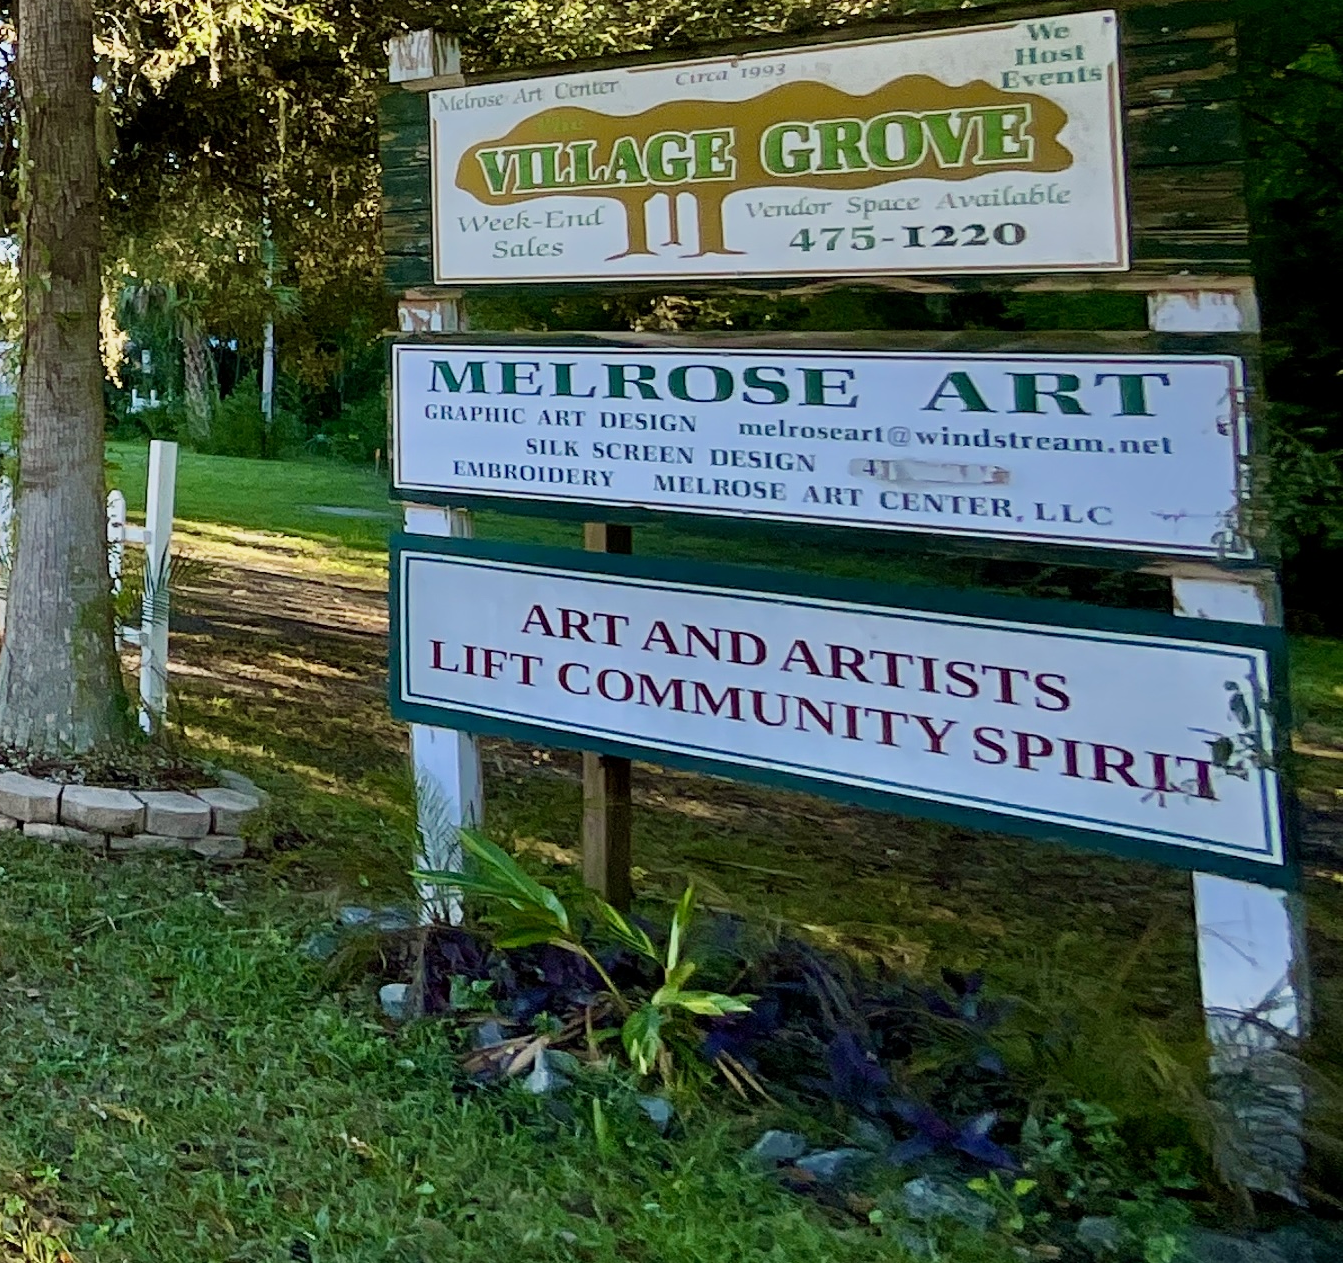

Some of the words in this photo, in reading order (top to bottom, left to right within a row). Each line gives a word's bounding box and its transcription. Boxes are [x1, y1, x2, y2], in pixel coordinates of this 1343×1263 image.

[1026, 23, 1071, 40] We
[1015, 44, 1085, 66] Host
[675, 69, 729, 86] Circa
[740, 63, 787, 79] 1993
[1001, 64, 1103, 89] Events
[438, 91, 505, 112] Melrose
[512, 87, 544, 106] Art
[554, 78, 621, 99] Center
[476, 128, 737, 195] VILLAGE
[760, 103, 1034, 177] GROVE
[746, 196, 832, 218] Vendor
[846, 195, 920, 220] Space
[935, 183, 1071, 210] Available
[457, 205, 606, 232] Week-End
[492, 236, 564, 259] Sales
[788, 222, 1027, 252] 475-1220
[427, 359, 859, 408] MELROSE
[919, 371, 1170, 417] ART
[424, 403, 526, 425] GRAPHIC
[537, 409, 586, 428] ART
[601, 411, 697, 432] DESIGN
[739, 419, 1172, 455] melroseart@windstream.net
[526, 438, 580, 457] SILK
[592, 441, 694, 464] SCREEN
[710, 448, 816, 472] DESIGN
[453, 460, 614, 487] EMBROIDERY
[654, 474, 787, 501] MELROSE
[802, 485, 862, 507] ART
[1034, 502, 1113, 526] LLC
[520, 604, 629, 647] ART
[641, 620, 767, 666] AND
[780, 639, 1070, 712] ARTISTS
[429, 639, 543, 687] LIFT
[558, 662, 958, 756] COMMUNITY
[973, 726, 1219, 801] SPIRIT
